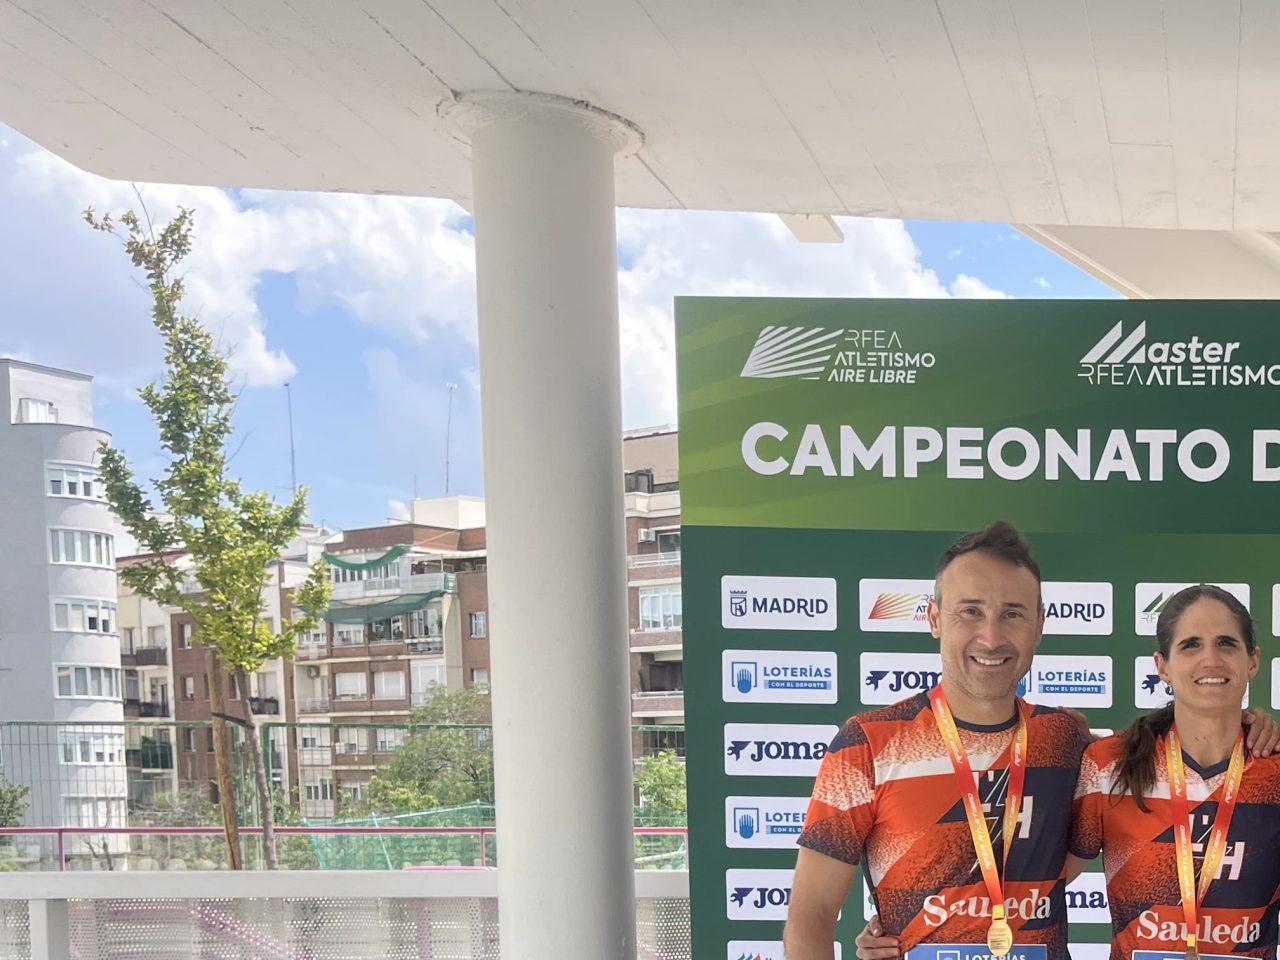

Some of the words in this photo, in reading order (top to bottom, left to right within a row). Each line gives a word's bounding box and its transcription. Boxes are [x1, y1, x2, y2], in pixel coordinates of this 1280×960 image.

[844, 329, 902, 348] RFEA
[834, 351, 935, 369] ATLETISMO
[827, 368, 864, 383] AIRE
[868, 368, 917, 384] LIBRE
[741, 421, 1231, 482] CAMPEONATO
[752, 597, 828, 618] MADRID
[1046, 603, 1105, 622] ADRID
[763, 665, 832, 678] LOTERÍAS
[1037, 669, 1106, 682] LOTERÍAS
[923, 888, 1051, 926] Saueda
